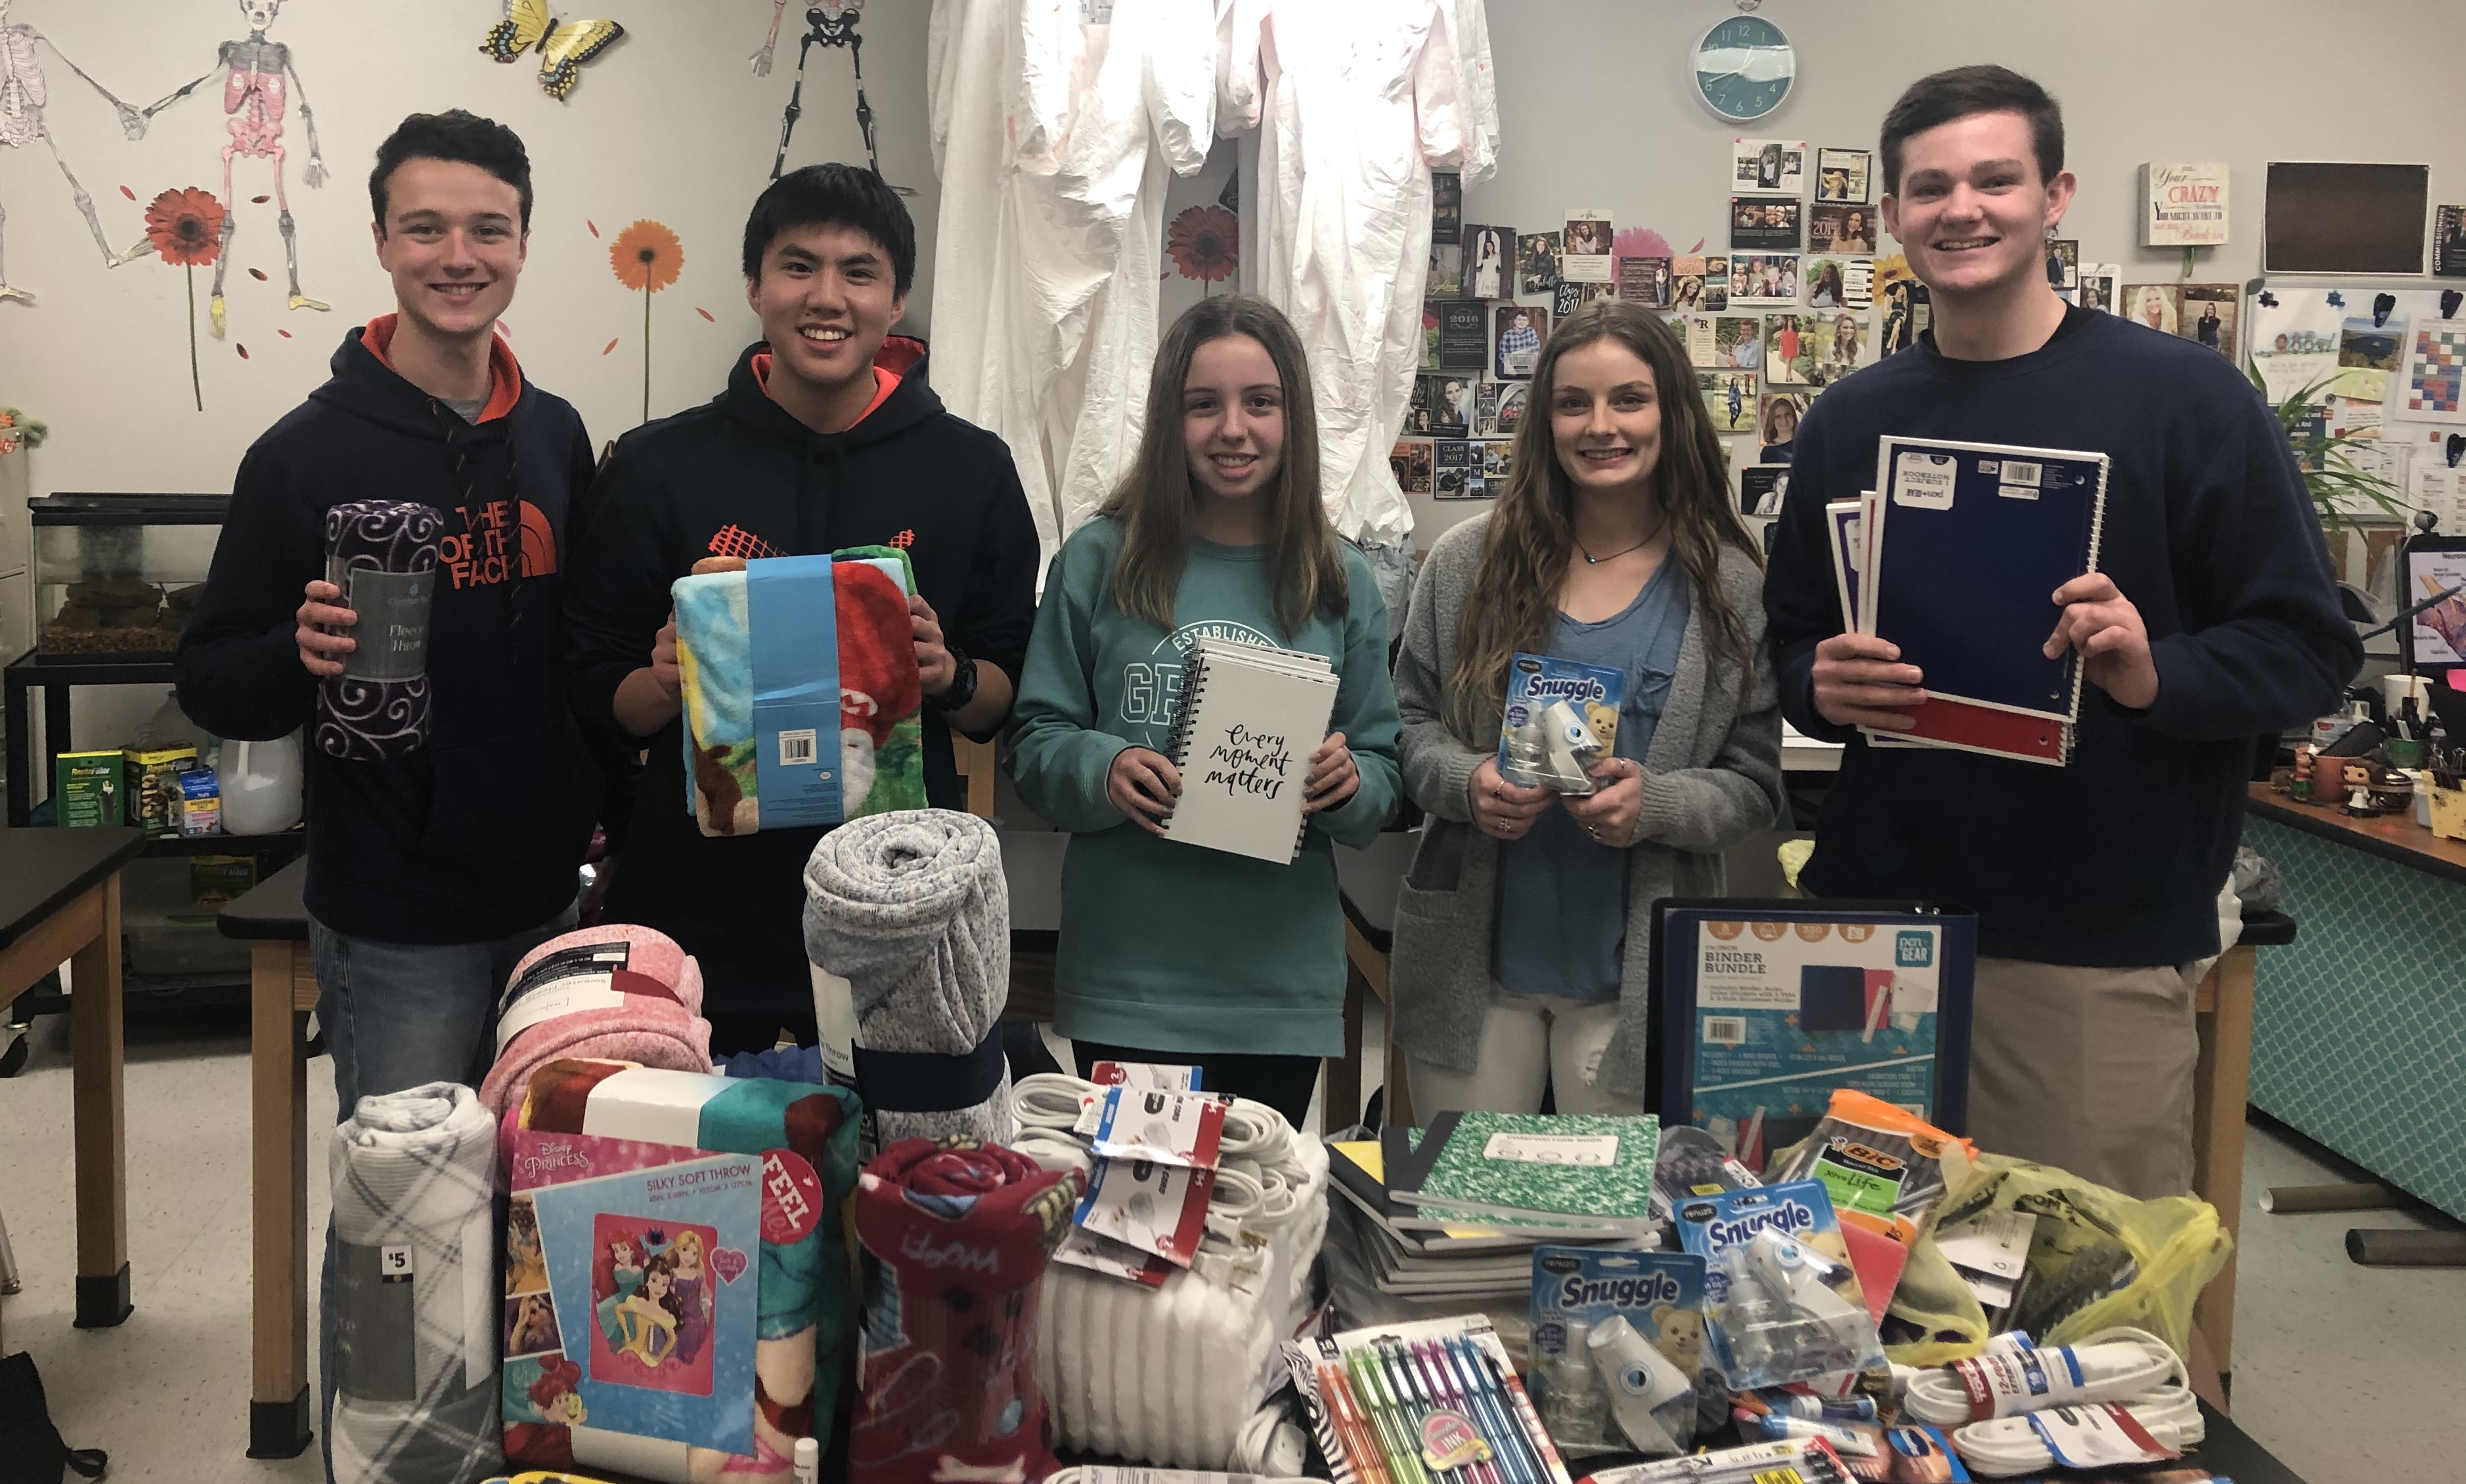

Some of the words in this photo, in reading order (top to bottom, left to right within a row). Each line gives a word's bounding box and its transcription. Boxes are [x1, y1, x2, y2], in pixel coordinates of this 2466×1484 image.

[1722, 30, 1730, 41] 11
[1738, 25, 1750, 37] 12
[1761, 32, 1765, 42] 1
[1776, 66, 1784, 76] 3
[1769, 83, 1776, 93] 4
[1719, 94, 1726, 105] 7
[1736, 101, 1743, 112] 6
[1755, 97, 1762, 107] 5
[2169, 185, 2219, 203] CRAZY
[2435, 207, 2445, 271] COMMISSIONING
[1560, 284, 1579, 297] Class
[1736, 283, 1742, 295] 2
[1786, 284, 1792, 295] 5
[1558, 299, 1579, 313] 2017
[1700, 320, 1709, 328] R
[1903, 471, 1950, 480] NOTEBOOK
[1905, 477, 1943, 485] SUBJECT
[455, 500, 510, 531] THE
[1171, 625, 1268, 651] ESTABLISHE
[1527, 676, 1604, 701] Snuggle
[1225, 724, 1285, 756] every
[1209, 745, 1293, 776] moment
[1204, 768, 1285, 800] matters
[1705, 952, 1763, 963] BINDER
[1902, 947, 1927, 961] GEAR
[1705, 963, 1767, 974] BUNDLE
[826, 1043, 848, 1061] Throw
[537, 1143, 572, 1156] Disney
[1848, 1147, 1896, 1166] BIC
[525, 1150, 588, 1179] PRINCESS
[647, 1177, 674, 1192] SILKY
[678, 1171, 705, 1186] SOFT
[709, 1164, 751, 1180] THROW
[762, 1154, 809, 1229] FEEL
[1709, 1202, 1811, 1248] Snuggle
[1889, 1226, 1903, 1238] 10
[388, 1252, 406, 1268] $5
[1562, 1273, 1677, 1307] Snuggle
[1319, 1338, 1335, 1351] 10
[1442, 1431, 1466, 1452] INK
